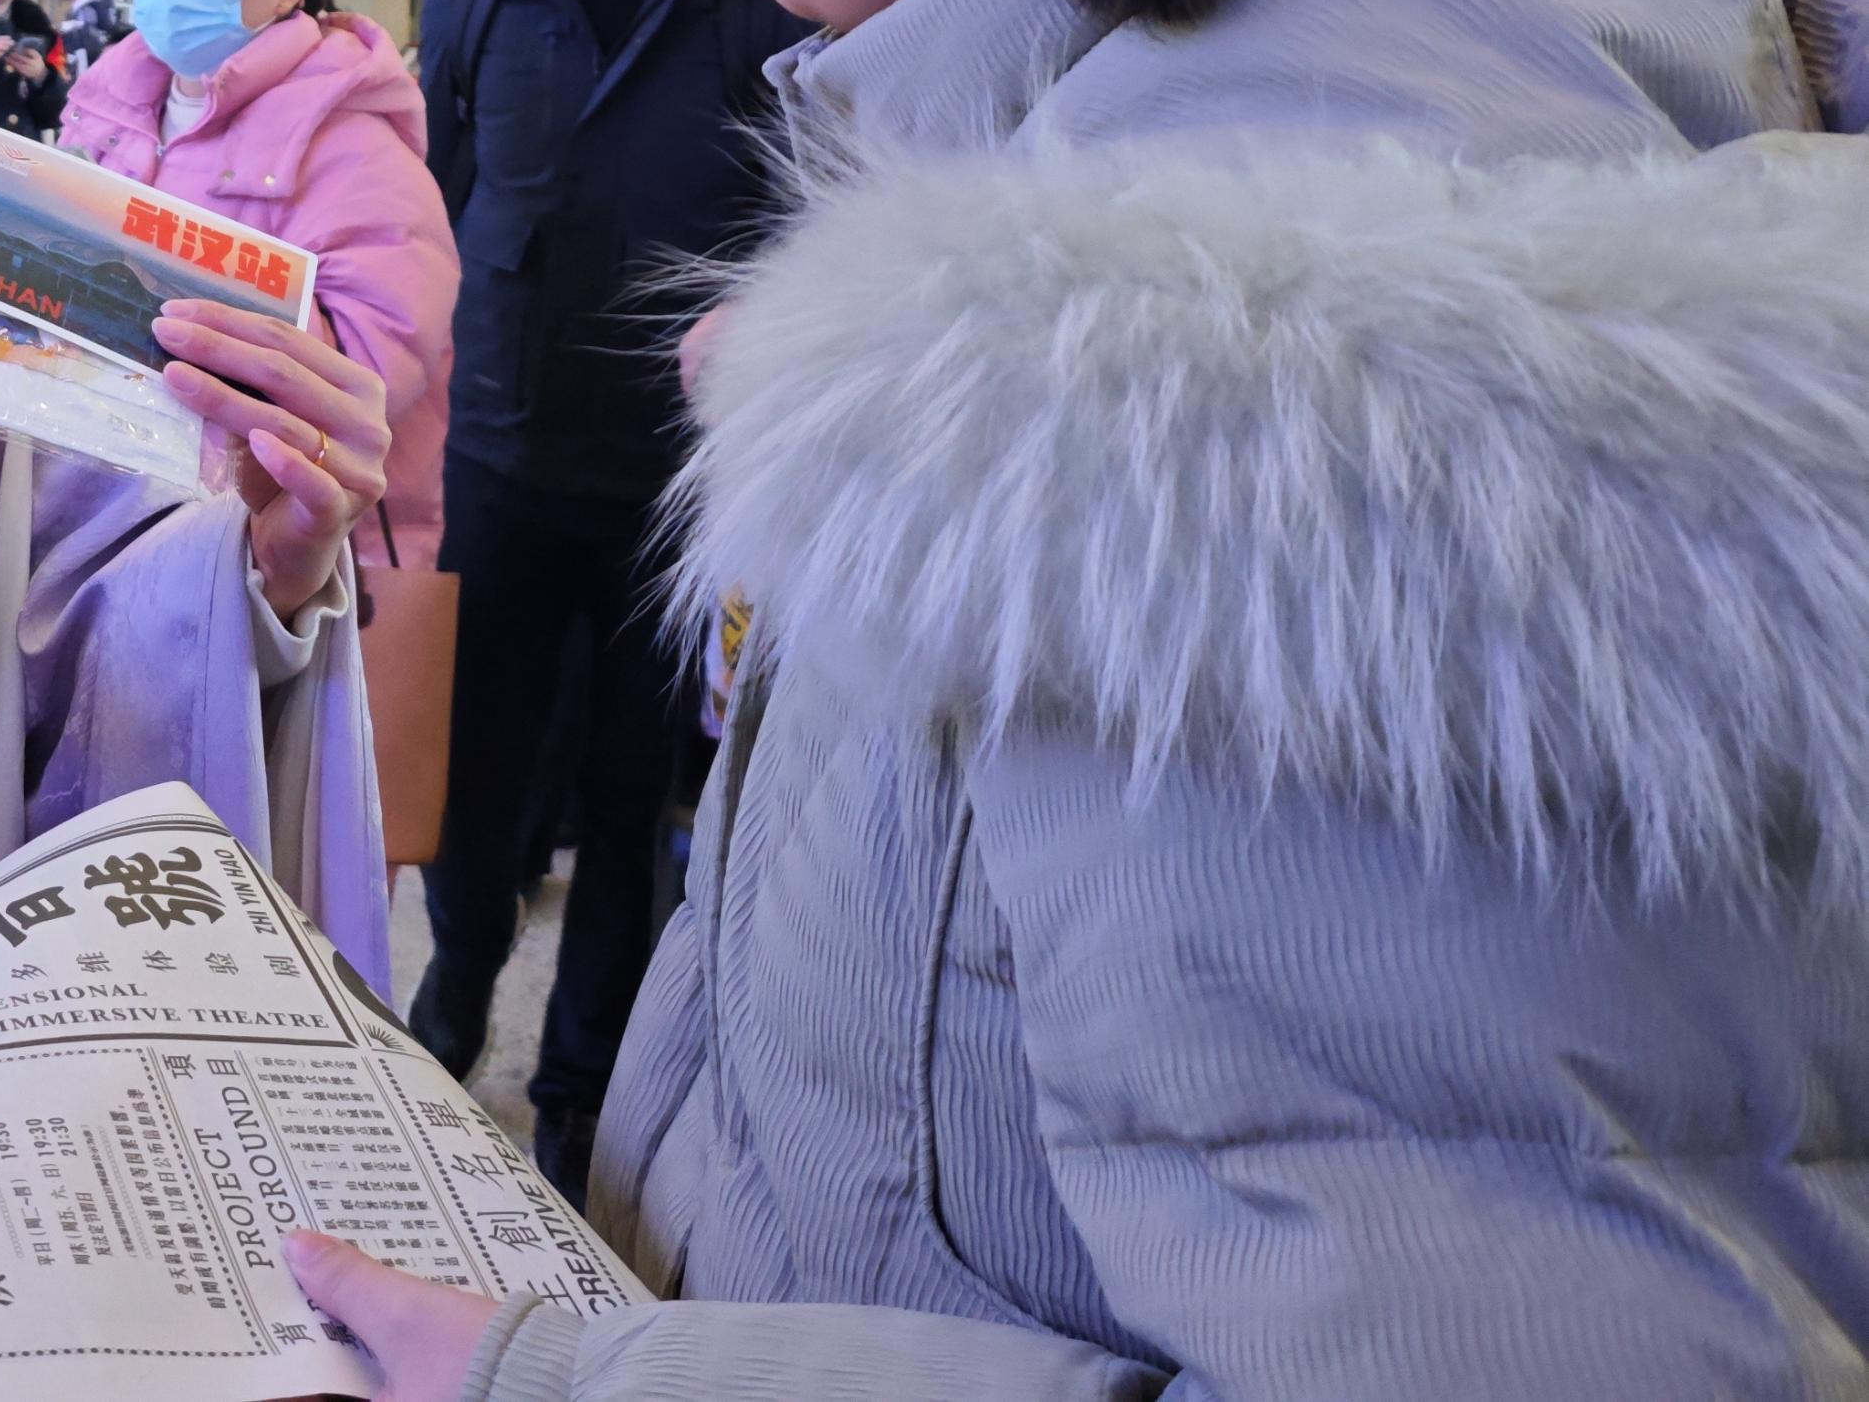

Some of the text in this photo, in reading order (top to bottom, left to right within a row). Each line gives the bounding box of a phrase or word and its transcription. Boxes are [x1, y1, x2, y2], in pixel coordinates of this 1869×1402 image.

[121, 196, 291, 300] 武汉站
[214, 849, 279, 936] ZHI YIN HAO
[190, 1007, 330, 1030] THEATRE
[25, 1118, 55, 1157] 19:30
[48, 1117, 78, 1156] 21:30
[194, 1128, 276, 1270] PROJECT
[468, 1106, 619, 1316] CREATIVE TEAM
